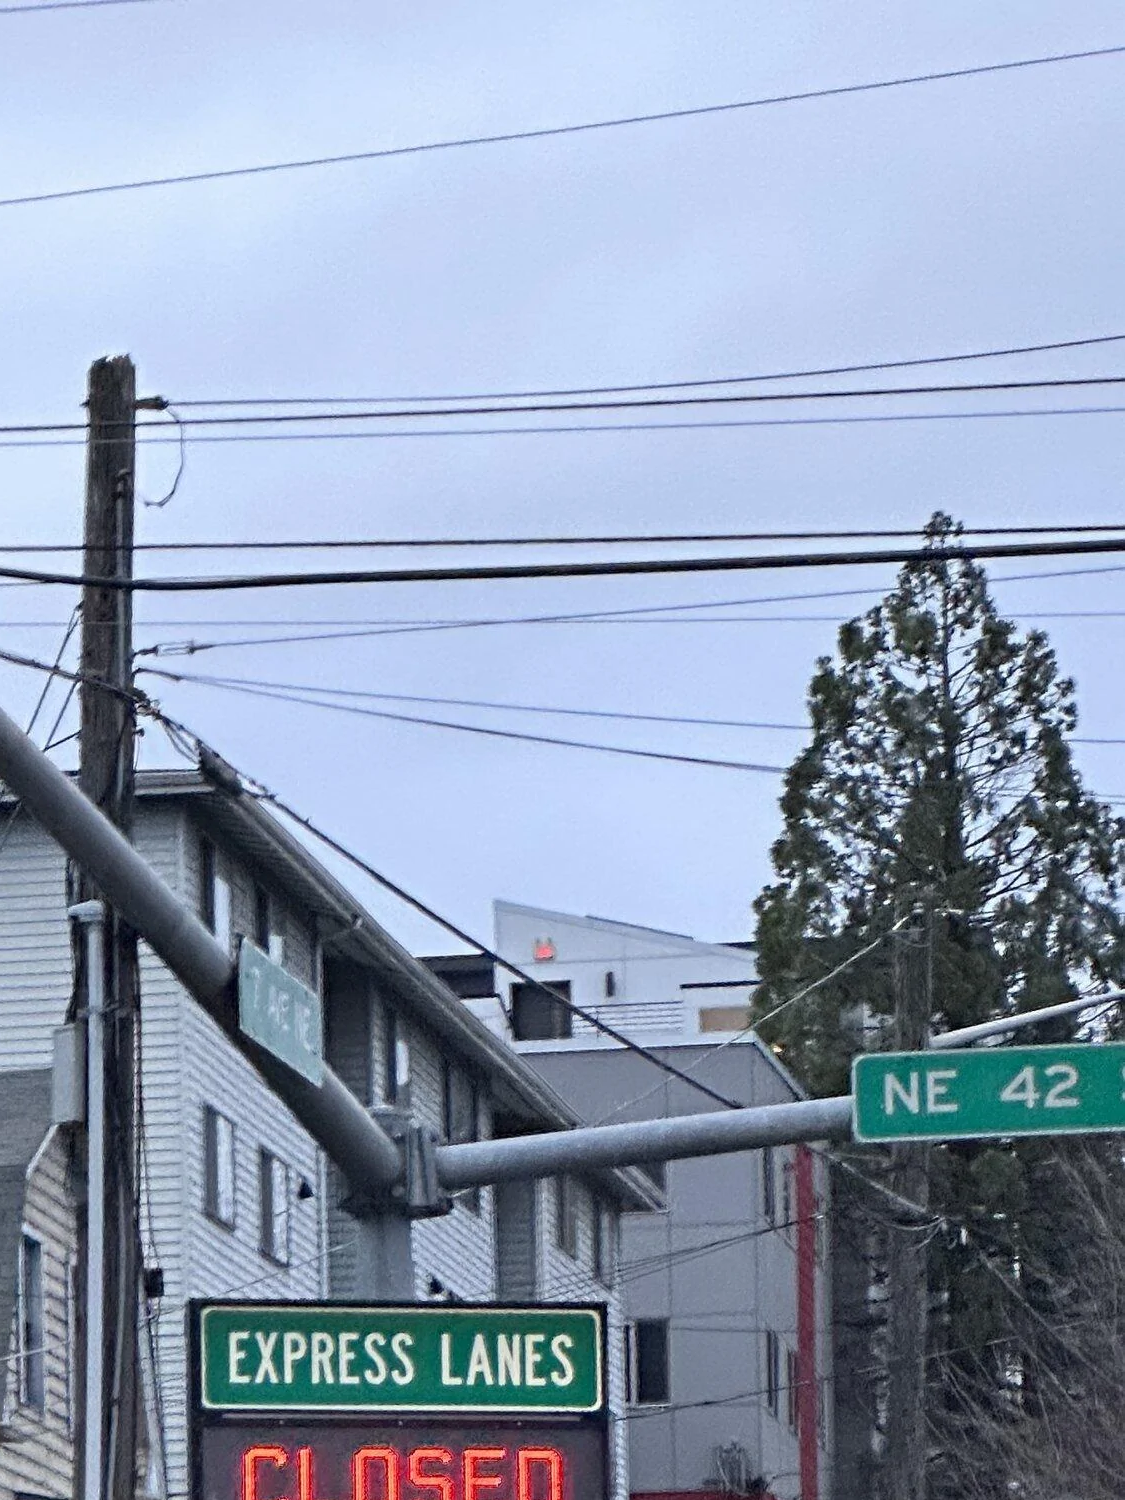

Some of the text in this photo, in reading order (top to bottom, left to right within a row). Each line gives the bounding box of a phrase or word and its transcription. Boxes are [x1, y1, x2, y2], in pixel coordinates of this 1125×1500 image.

[884, 1069, 959, 1116] NE
[1000, 1064, 1080, 1109] 42
[228, 1330, 574, 1387] EXPRESS LANES
